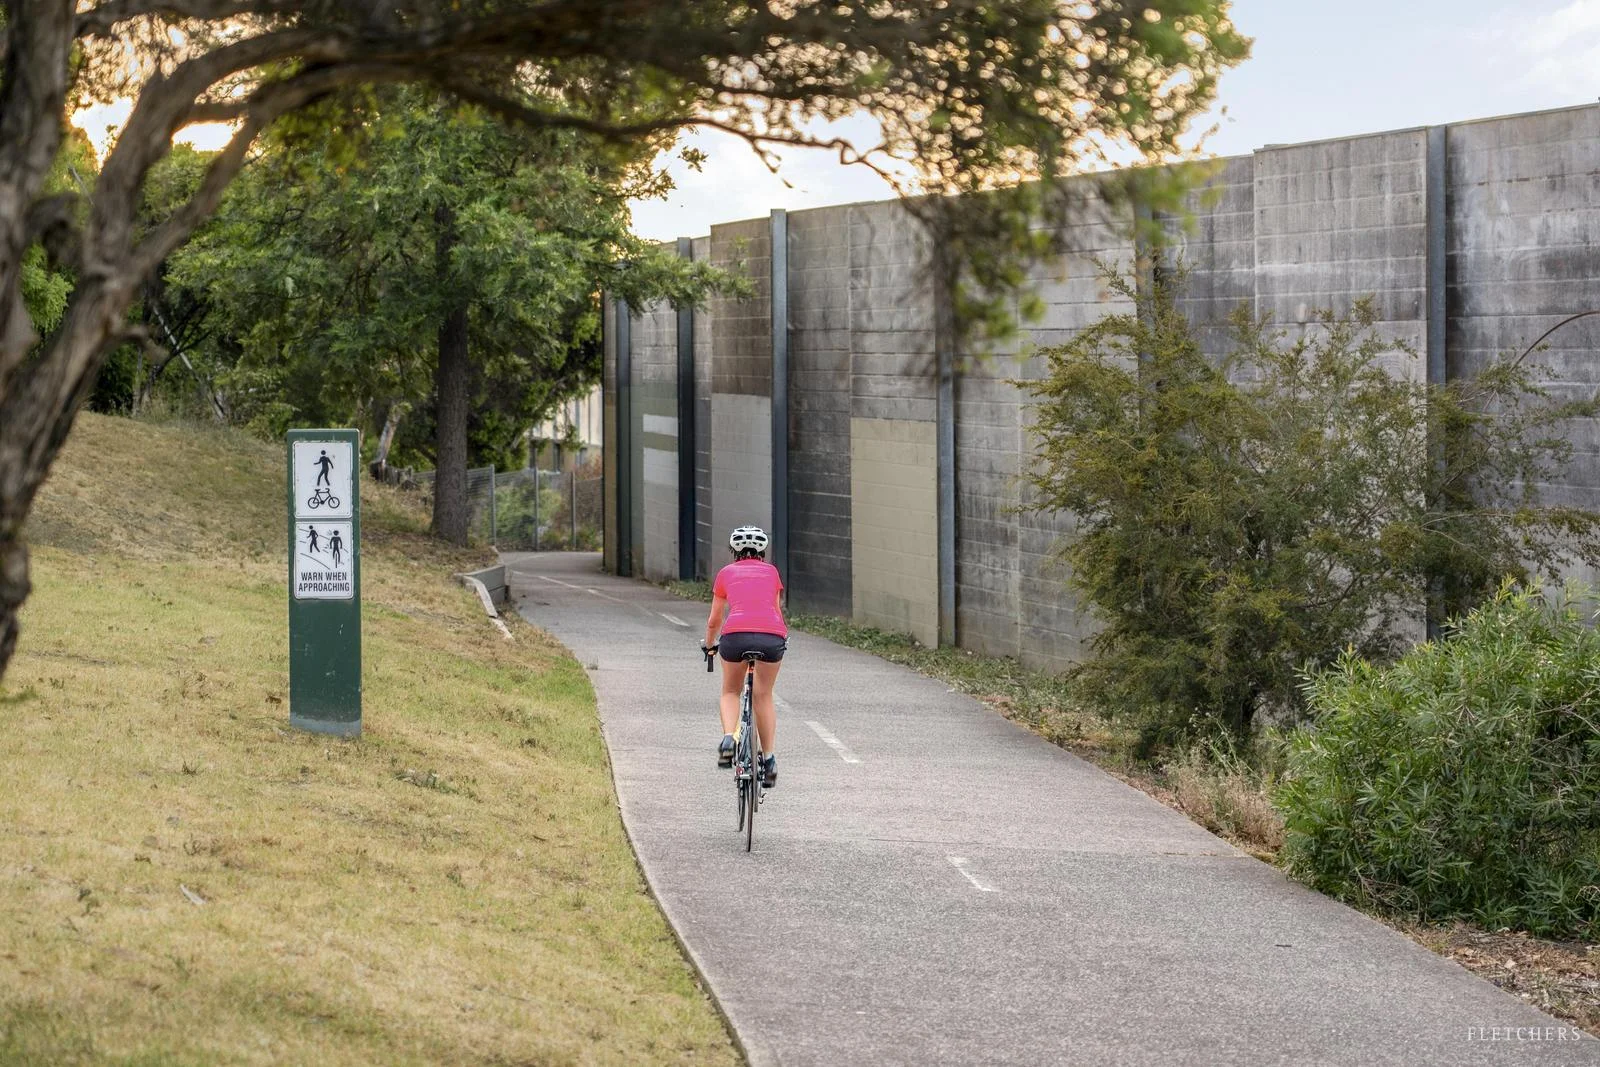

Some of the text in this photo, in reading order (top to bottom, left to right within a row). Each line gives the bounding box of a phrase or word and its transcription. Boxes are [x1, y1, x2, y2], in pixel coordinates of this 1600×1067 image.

[301, 571, 347, 581] WARN WHEN
[298, 582, 350, 592] APPROACHING
